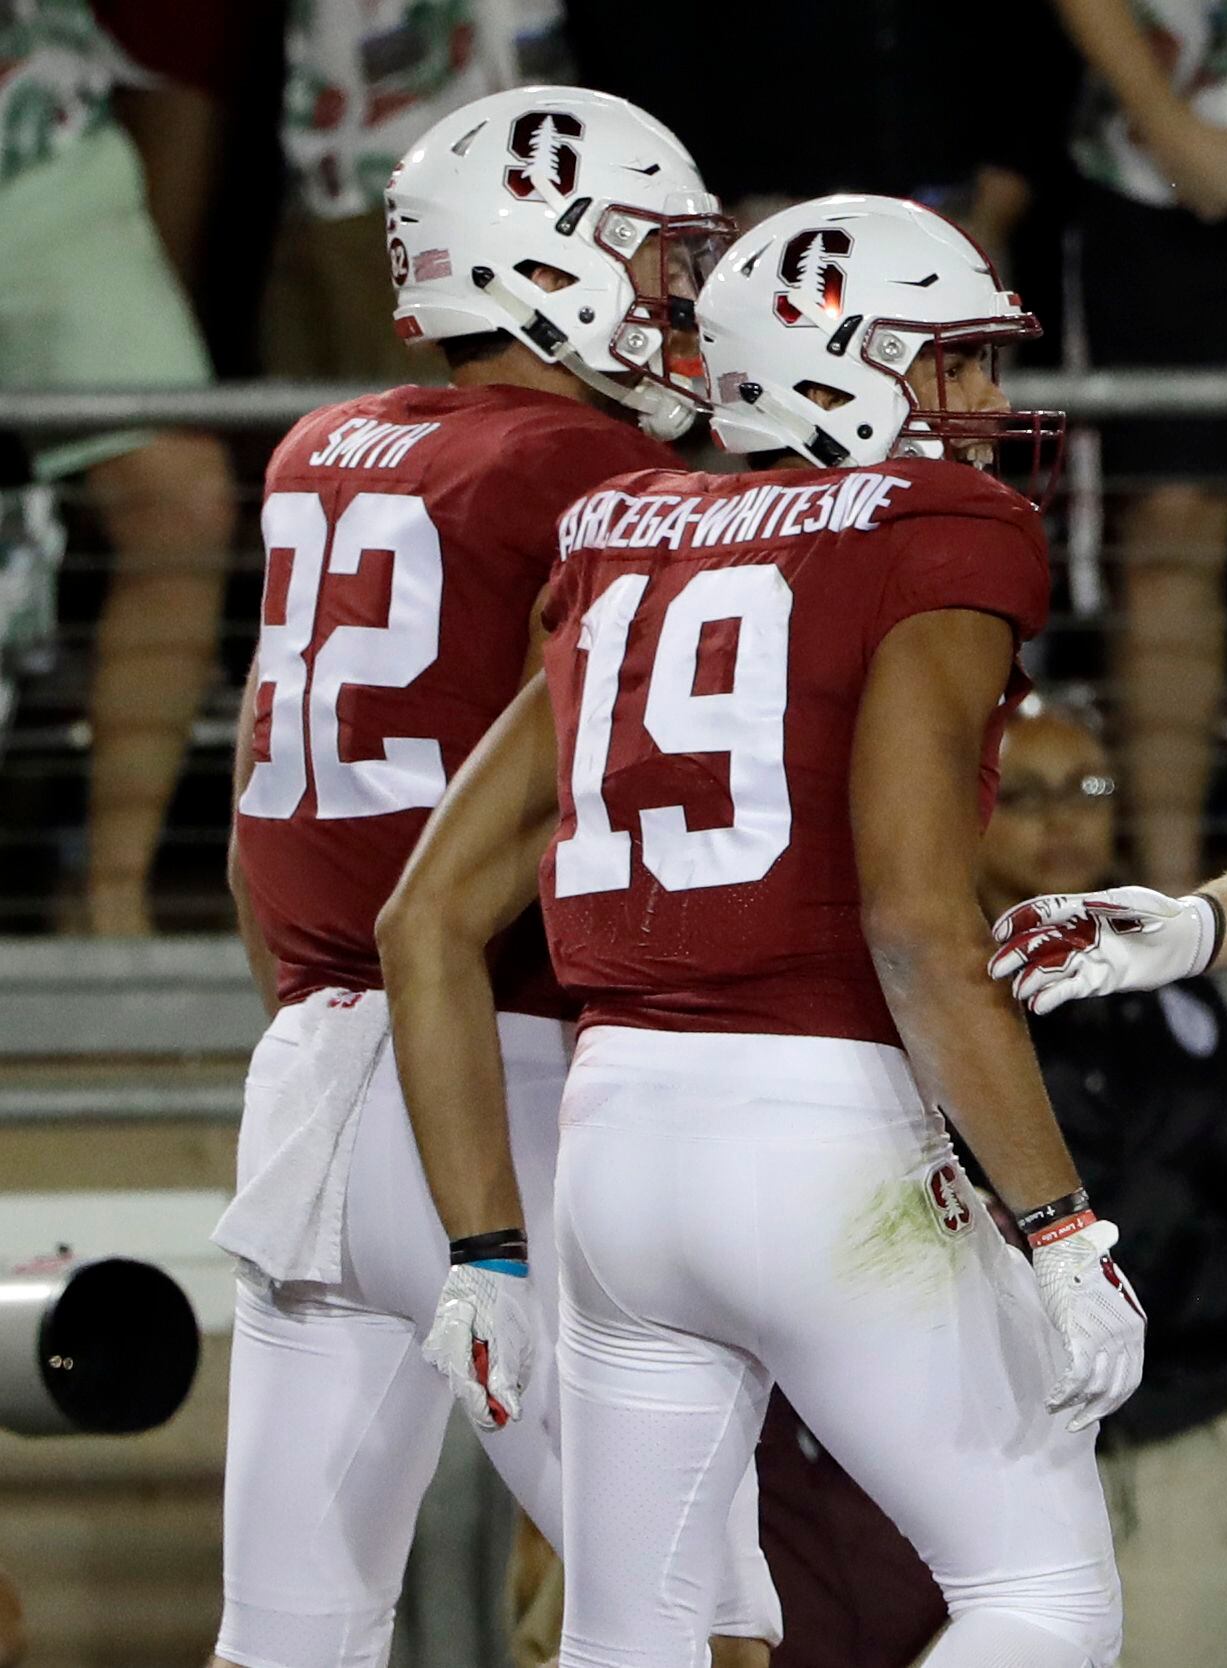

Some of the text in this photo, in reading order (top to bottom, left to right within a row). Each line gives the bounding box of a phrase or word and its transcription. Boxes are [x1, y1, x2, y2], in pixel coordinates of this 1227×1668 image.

[309, 417, 441, 469] SMITH
[239, 491, 446, 820] 82
[555, 563, 793, 899] 19
